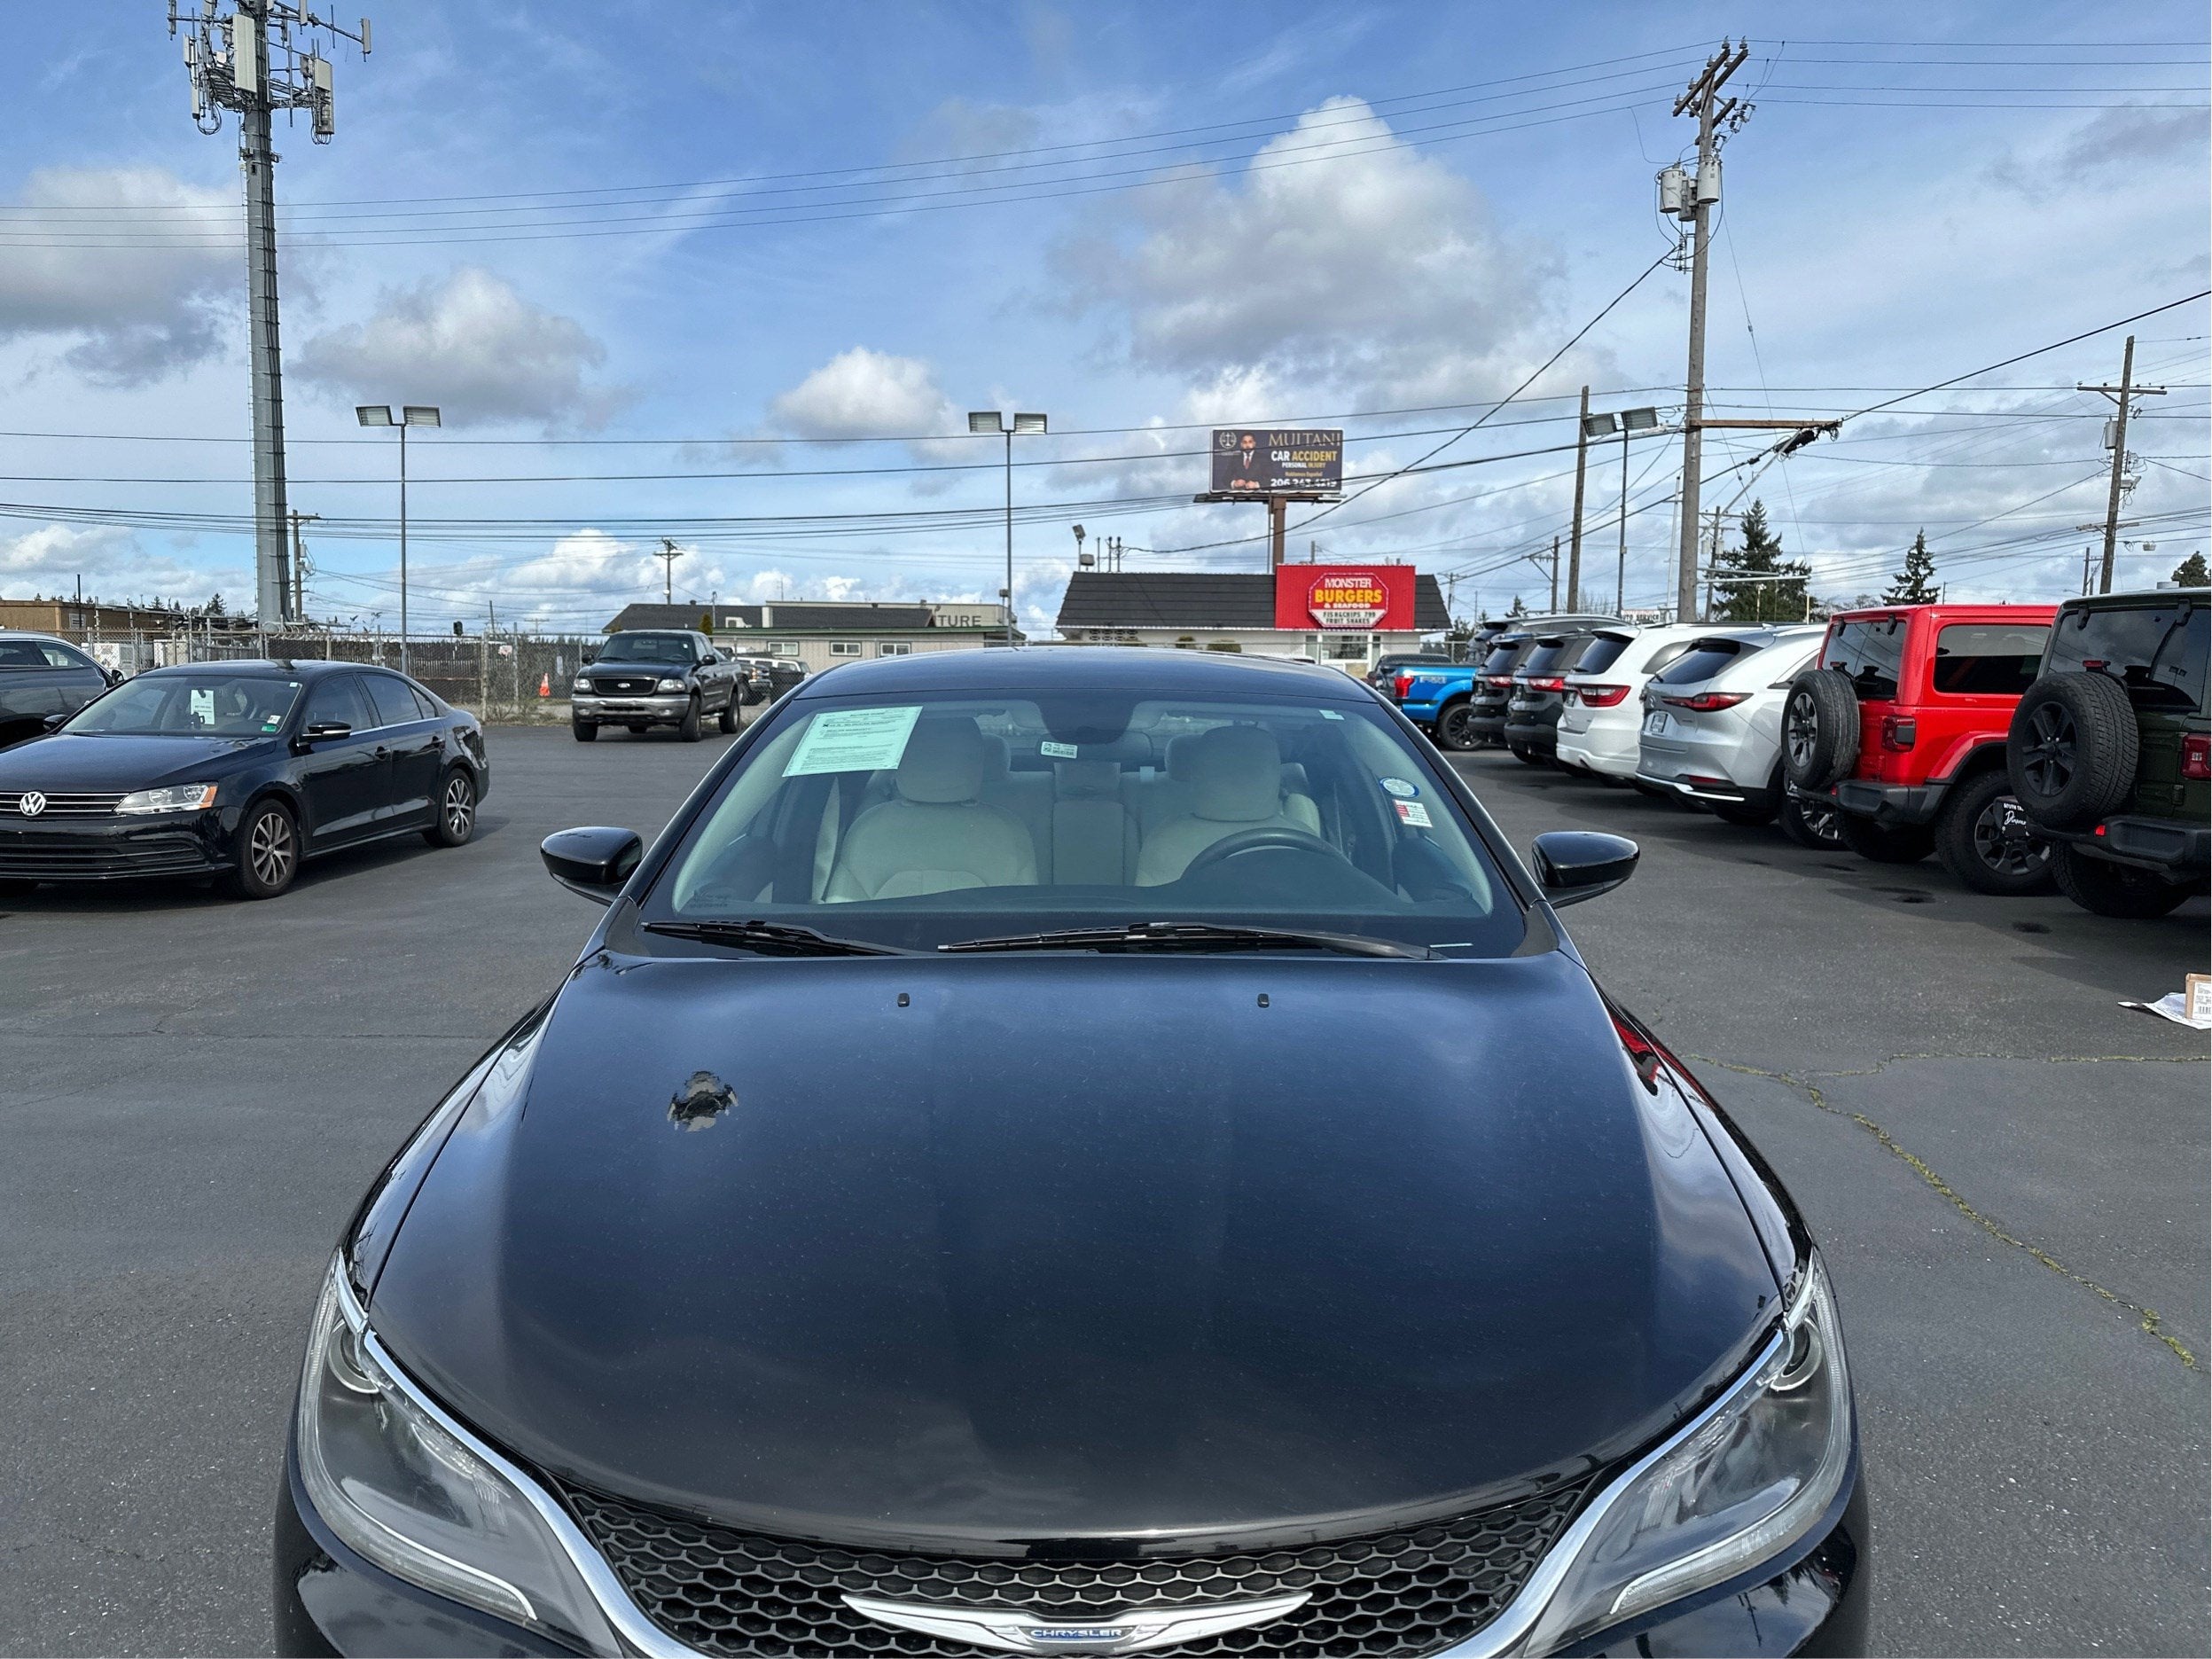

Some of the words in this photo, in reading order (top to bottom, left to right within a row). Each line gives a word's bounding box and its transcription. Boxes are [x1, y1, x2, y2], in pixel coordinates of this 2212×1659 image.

[1270, 450, 1290, 461] CAR
[1292, 450, 1337, 461] ACCIDENT
[1325, 578, 1372, 588] MONSTER
[1315, 590, 1382, 603] BURGERS
[1030, 1629, 1122, 1638] CHRYSLER
